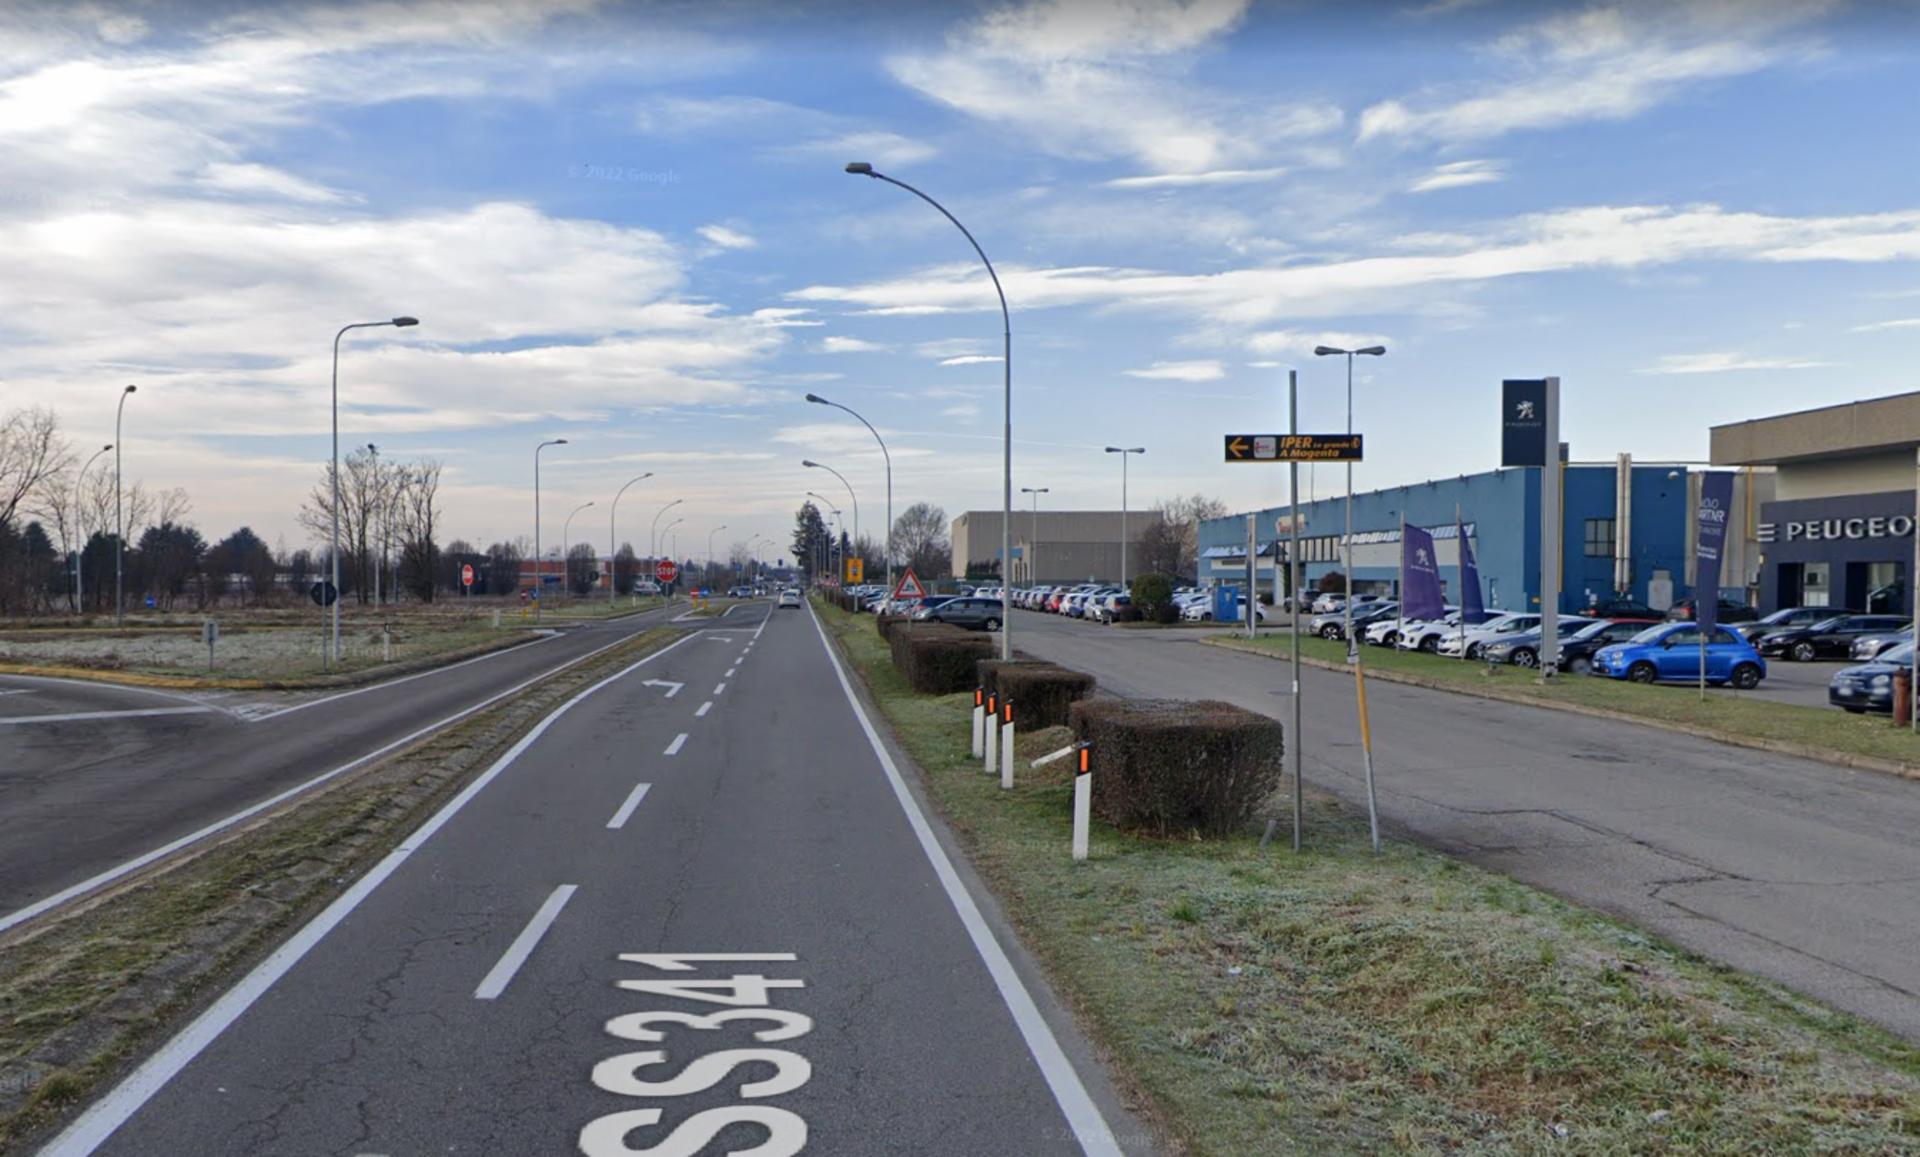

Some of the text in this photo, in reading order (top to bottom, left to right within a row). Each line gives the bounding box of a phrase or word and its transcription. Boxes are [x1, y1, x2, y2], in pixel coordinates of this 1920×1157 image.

[1280, 436, 1313, 449] IPER
[1279, 449, 1288, 458] A
[1786, 515, 1916, 541] PEUGEO
[656, 567, 676, 576] STOP
[578, 952, 815, 1157] SS341
